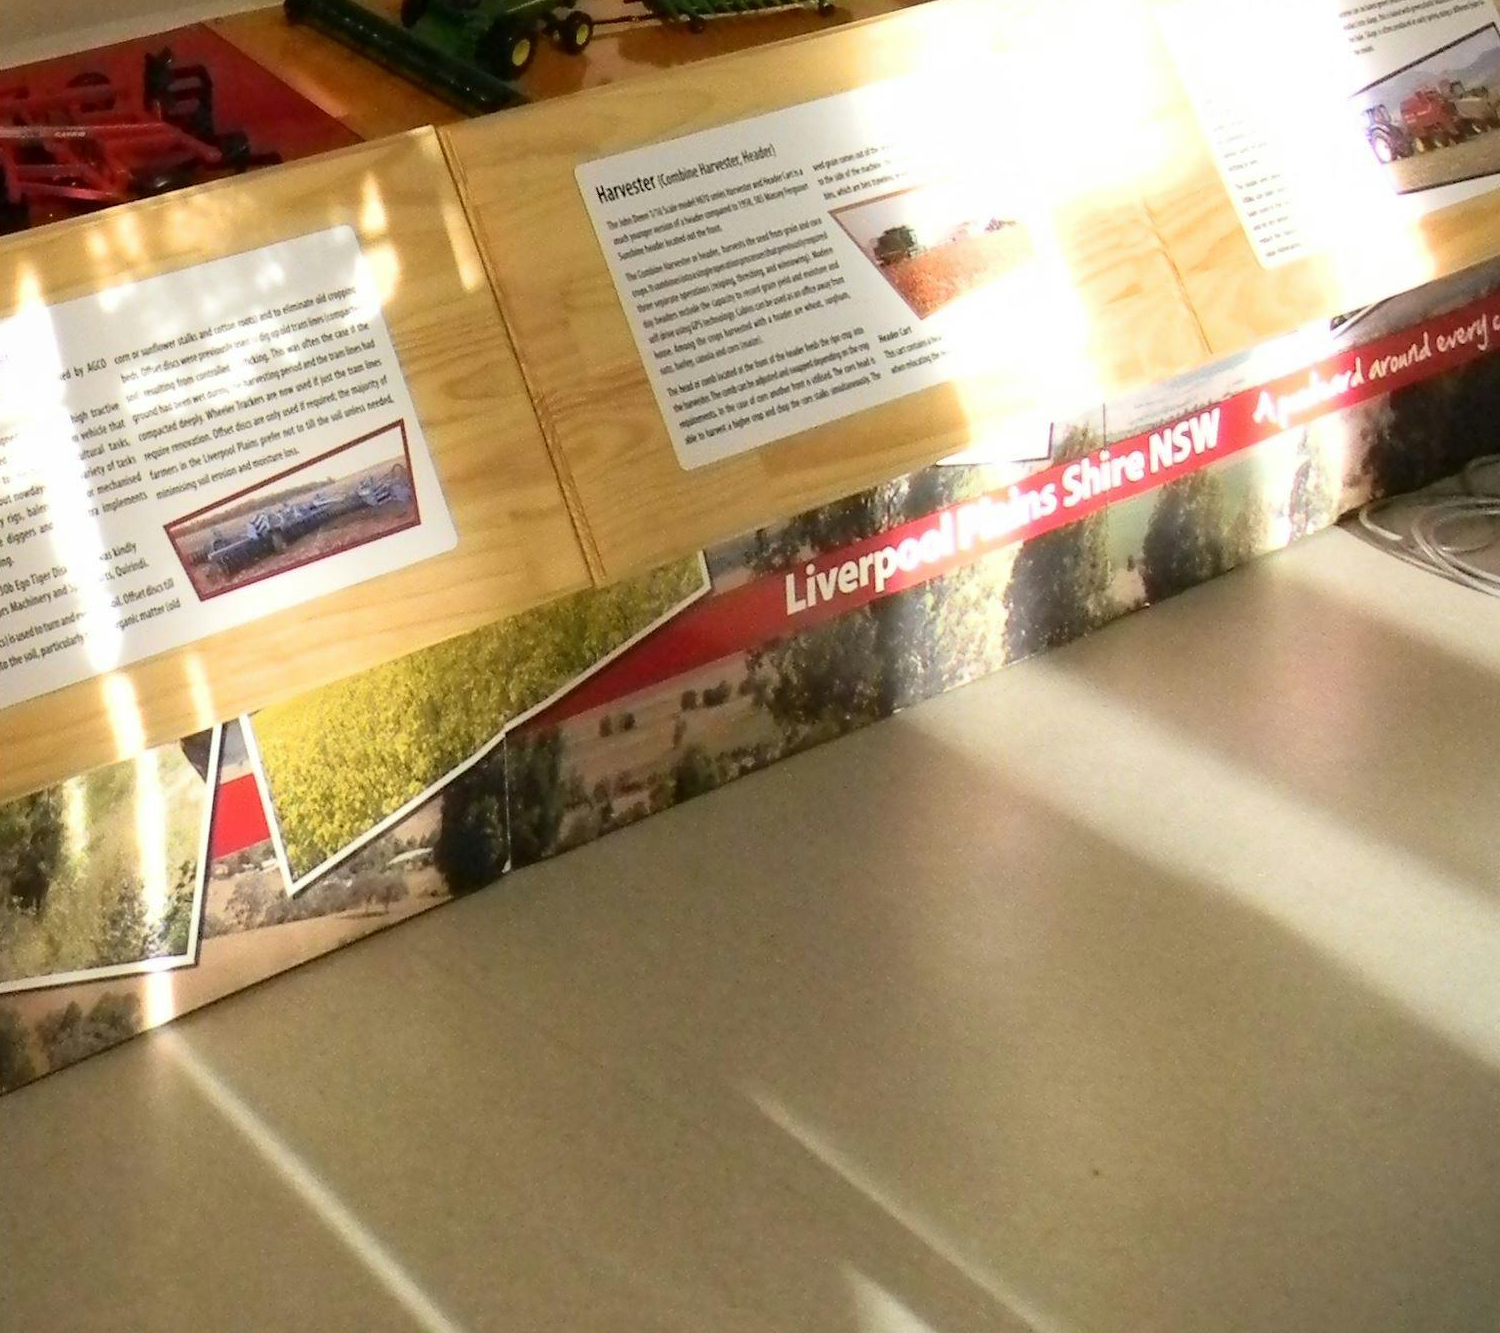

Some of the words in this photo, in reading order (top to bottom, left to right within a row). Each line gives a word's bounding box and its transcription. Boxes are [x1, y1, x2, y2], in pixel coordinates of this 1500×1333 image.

[595, 174, 656, 204] Harvester
[657, 168, 700, 190] (Combine
[698, 155, 743, 176] Harvester,
[742, 143, 776, 163] Header)
[1369, 332, 1432, 379] around
[1436, 314, 1488, 351] every
[786, 512, 955, 616] Liverpool
[1061, 447, 1145, 508] Shire
[1149, 408, 1221, 473] NSW
